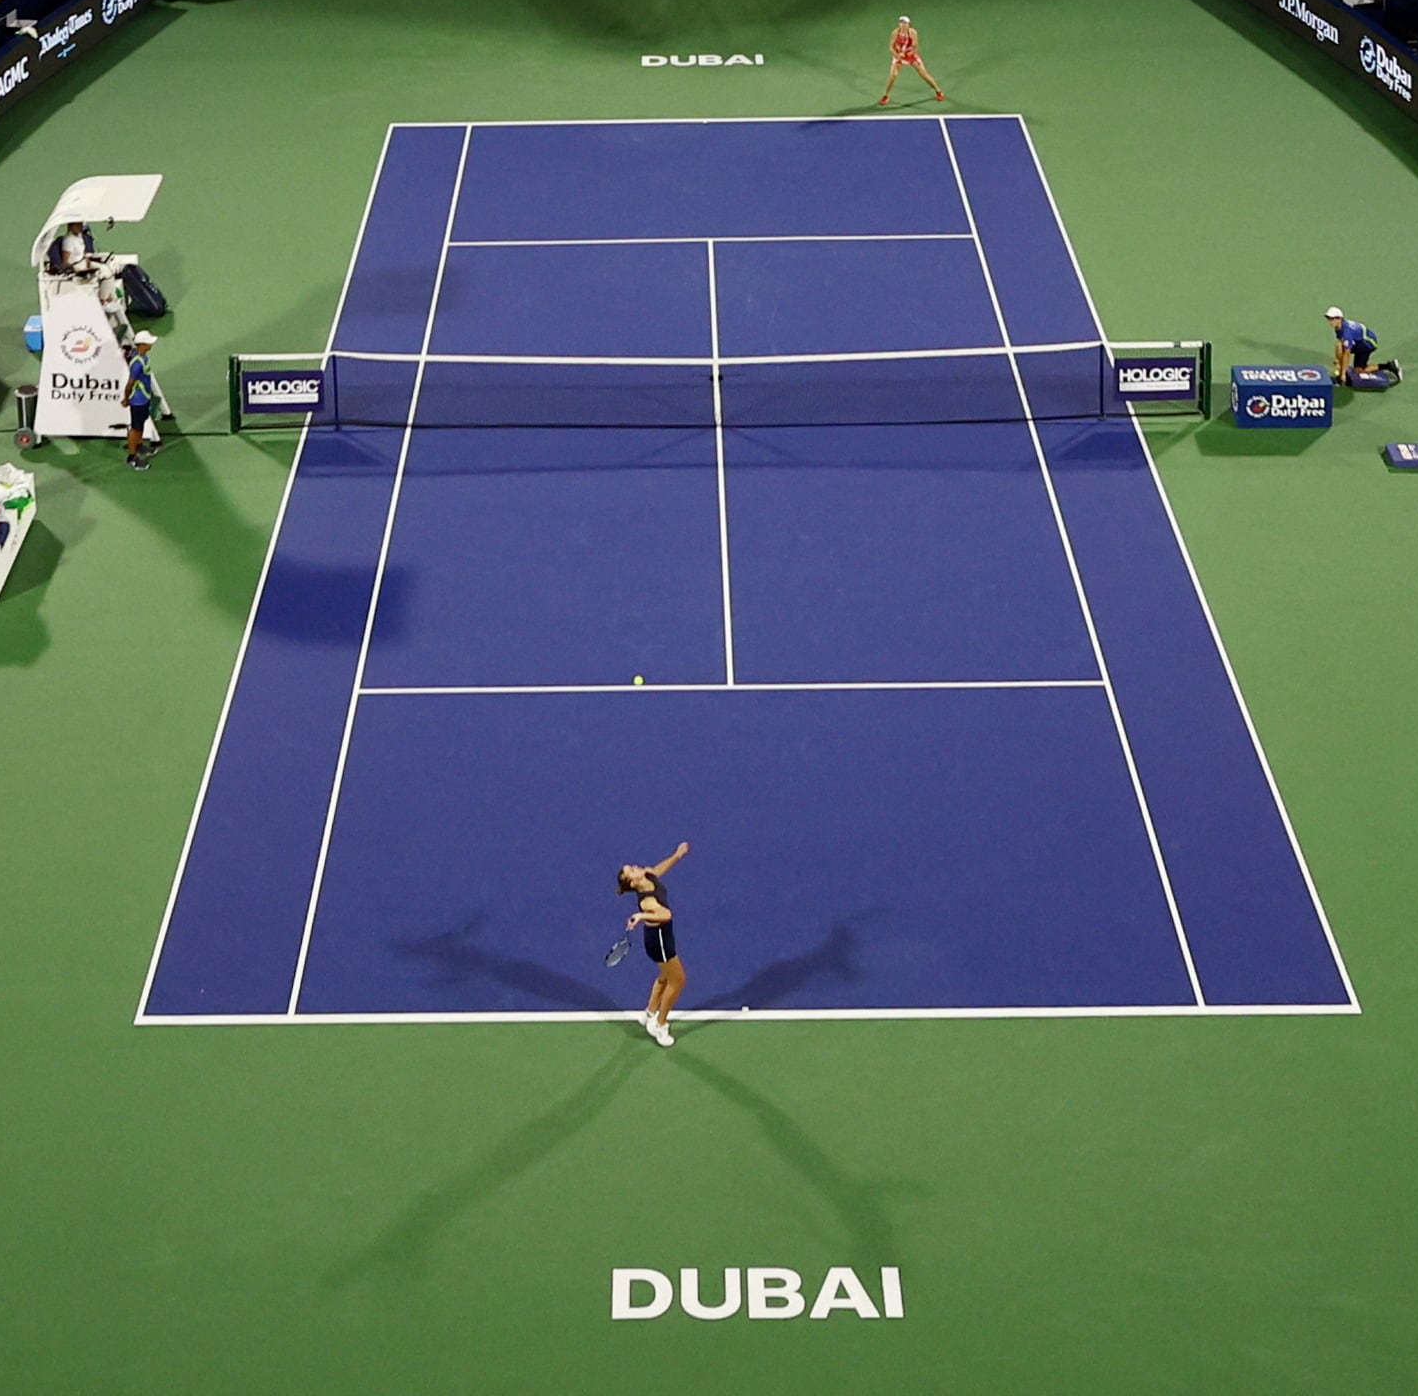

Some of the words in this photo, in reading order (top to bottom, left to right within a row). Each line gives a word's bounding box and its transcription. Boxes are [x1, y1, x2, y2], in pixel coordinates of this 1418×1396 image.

[641, 54, 764, 67] DUBAI
[1376, 44, 1412, 89] Dubai
[51, 373, 119, 390] Dubai
[1119, 367, 1191, 382] HOLOGIC
[247, 379, 319, 395] HOLOGIC
[51, 389, 85, 403] Duty
[89, 390, 120, 402] Free
[1271, 394, 1326, 408] Dubai
[1271, 407, 1298, 419] Duty
[1300, 407, 1326, 417] Free
[611, 1266, 905, 1320] DUBAI
